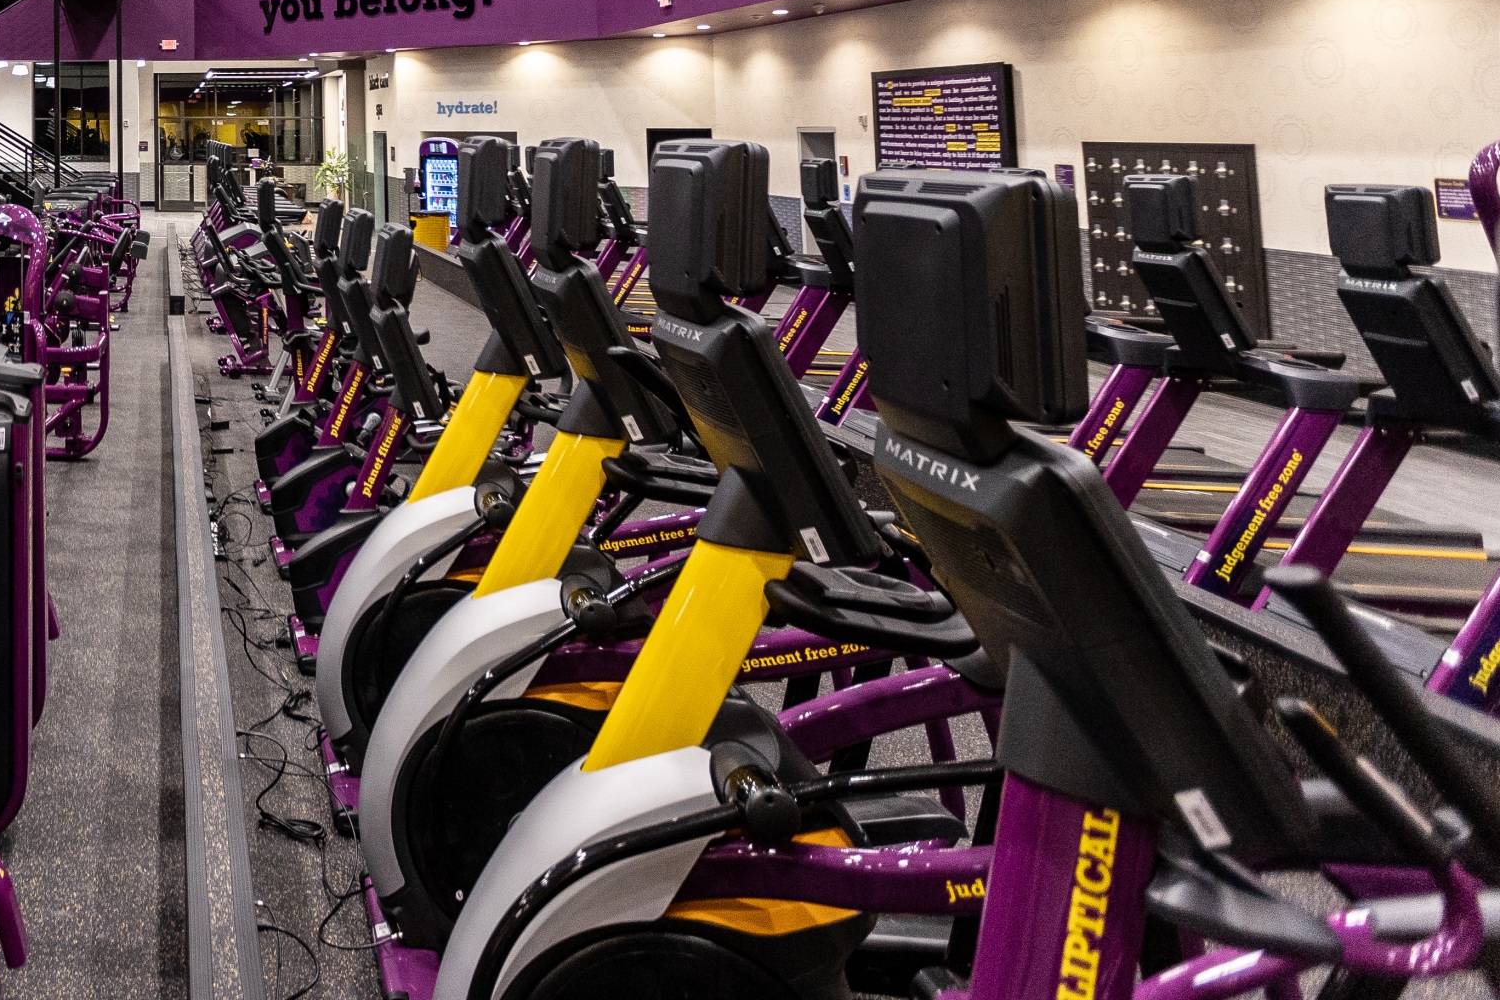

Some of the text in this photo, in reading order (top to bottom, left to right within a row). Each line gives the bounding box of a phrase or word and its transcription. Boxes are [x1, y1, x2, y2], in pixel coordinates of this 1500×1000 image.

[436, 101, 498, 117] hydrate!
[1138, 253, 1173, 261] MATRIX
[1344, 278, 1398, 291] MATRIX
[627, 325, 649, 333] lanet
[657, 316, 704, 342] MATRIX
[307, 333, 335, 393] planet fitness
[330, 369, 363, 438] planet fitness
[832, 377, 862, 415] judgement
[1090, 400, 1125, 450] free zone
[362, 416, 402, 498] planet fitness
[885, 436, 981, 492] MATRIX
[659, 528, 685, 542] free
[1216, 450, 1303, 582] judgement free zone
[742, 650, 803, 672] gement
[805, 644, 838, 662] free
[1056, 807, 1120, 1000] LIPTICAL
